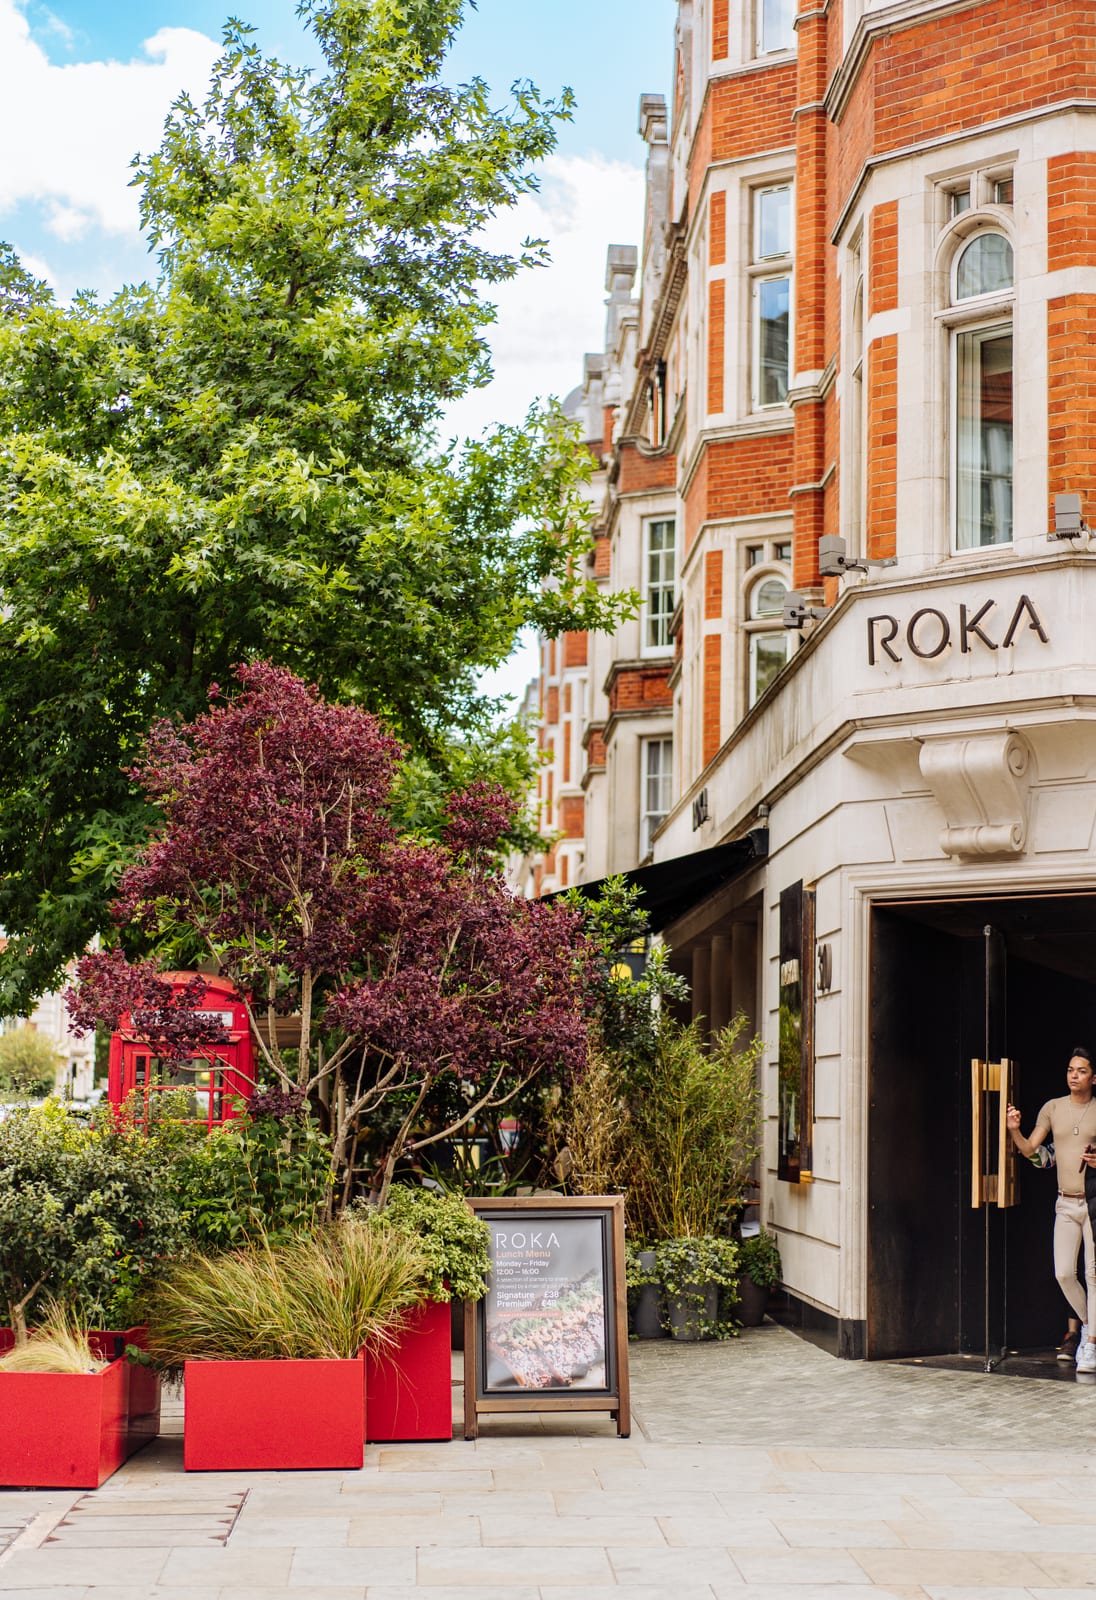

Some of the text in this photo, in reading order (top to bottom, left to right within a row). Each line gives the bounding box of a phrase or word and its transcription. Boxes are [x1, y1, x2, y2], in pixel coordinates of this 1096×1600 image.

[867, 594, 1049, 665] ROKA
[496, 1232, 560, 1249] ROKA
[496, 1250, 551, 1258] Lunch Menu
[496, 1260, 522, 1268] Monday
[529, 1260, 550, 1268] Friday
[496, 1291, 535, 1300] Signature
[496, 1300, 533, 1308] Premium
